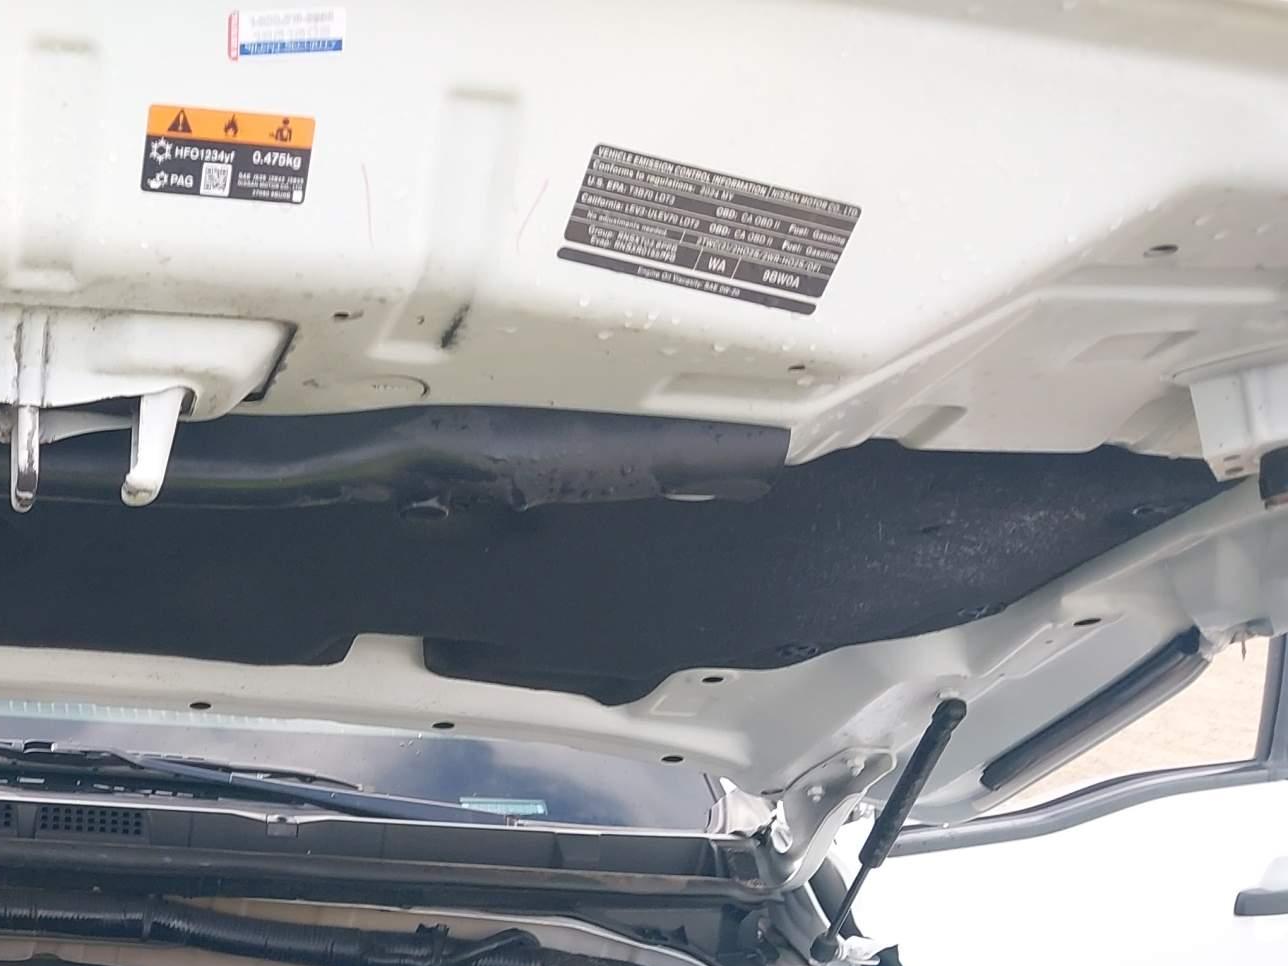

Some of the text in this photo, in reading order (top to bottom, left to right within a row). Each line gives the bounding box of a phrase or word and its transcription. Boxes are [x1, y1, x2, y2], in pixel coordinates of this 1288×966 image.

[174, 147, 302, 170] HFO1234yf 0.475kg
[593, 159, 634, 178] Conforms
[598, 146, 633, 163] VEHICLE
[633, 154, 674, 174] EMISSION
[675, 164, 711, 182] CONTROL
[712, 172, 767, 197] INFORMATION
[170, 172, 194, 189] PAG
[707, 256, 727, 273] WA
